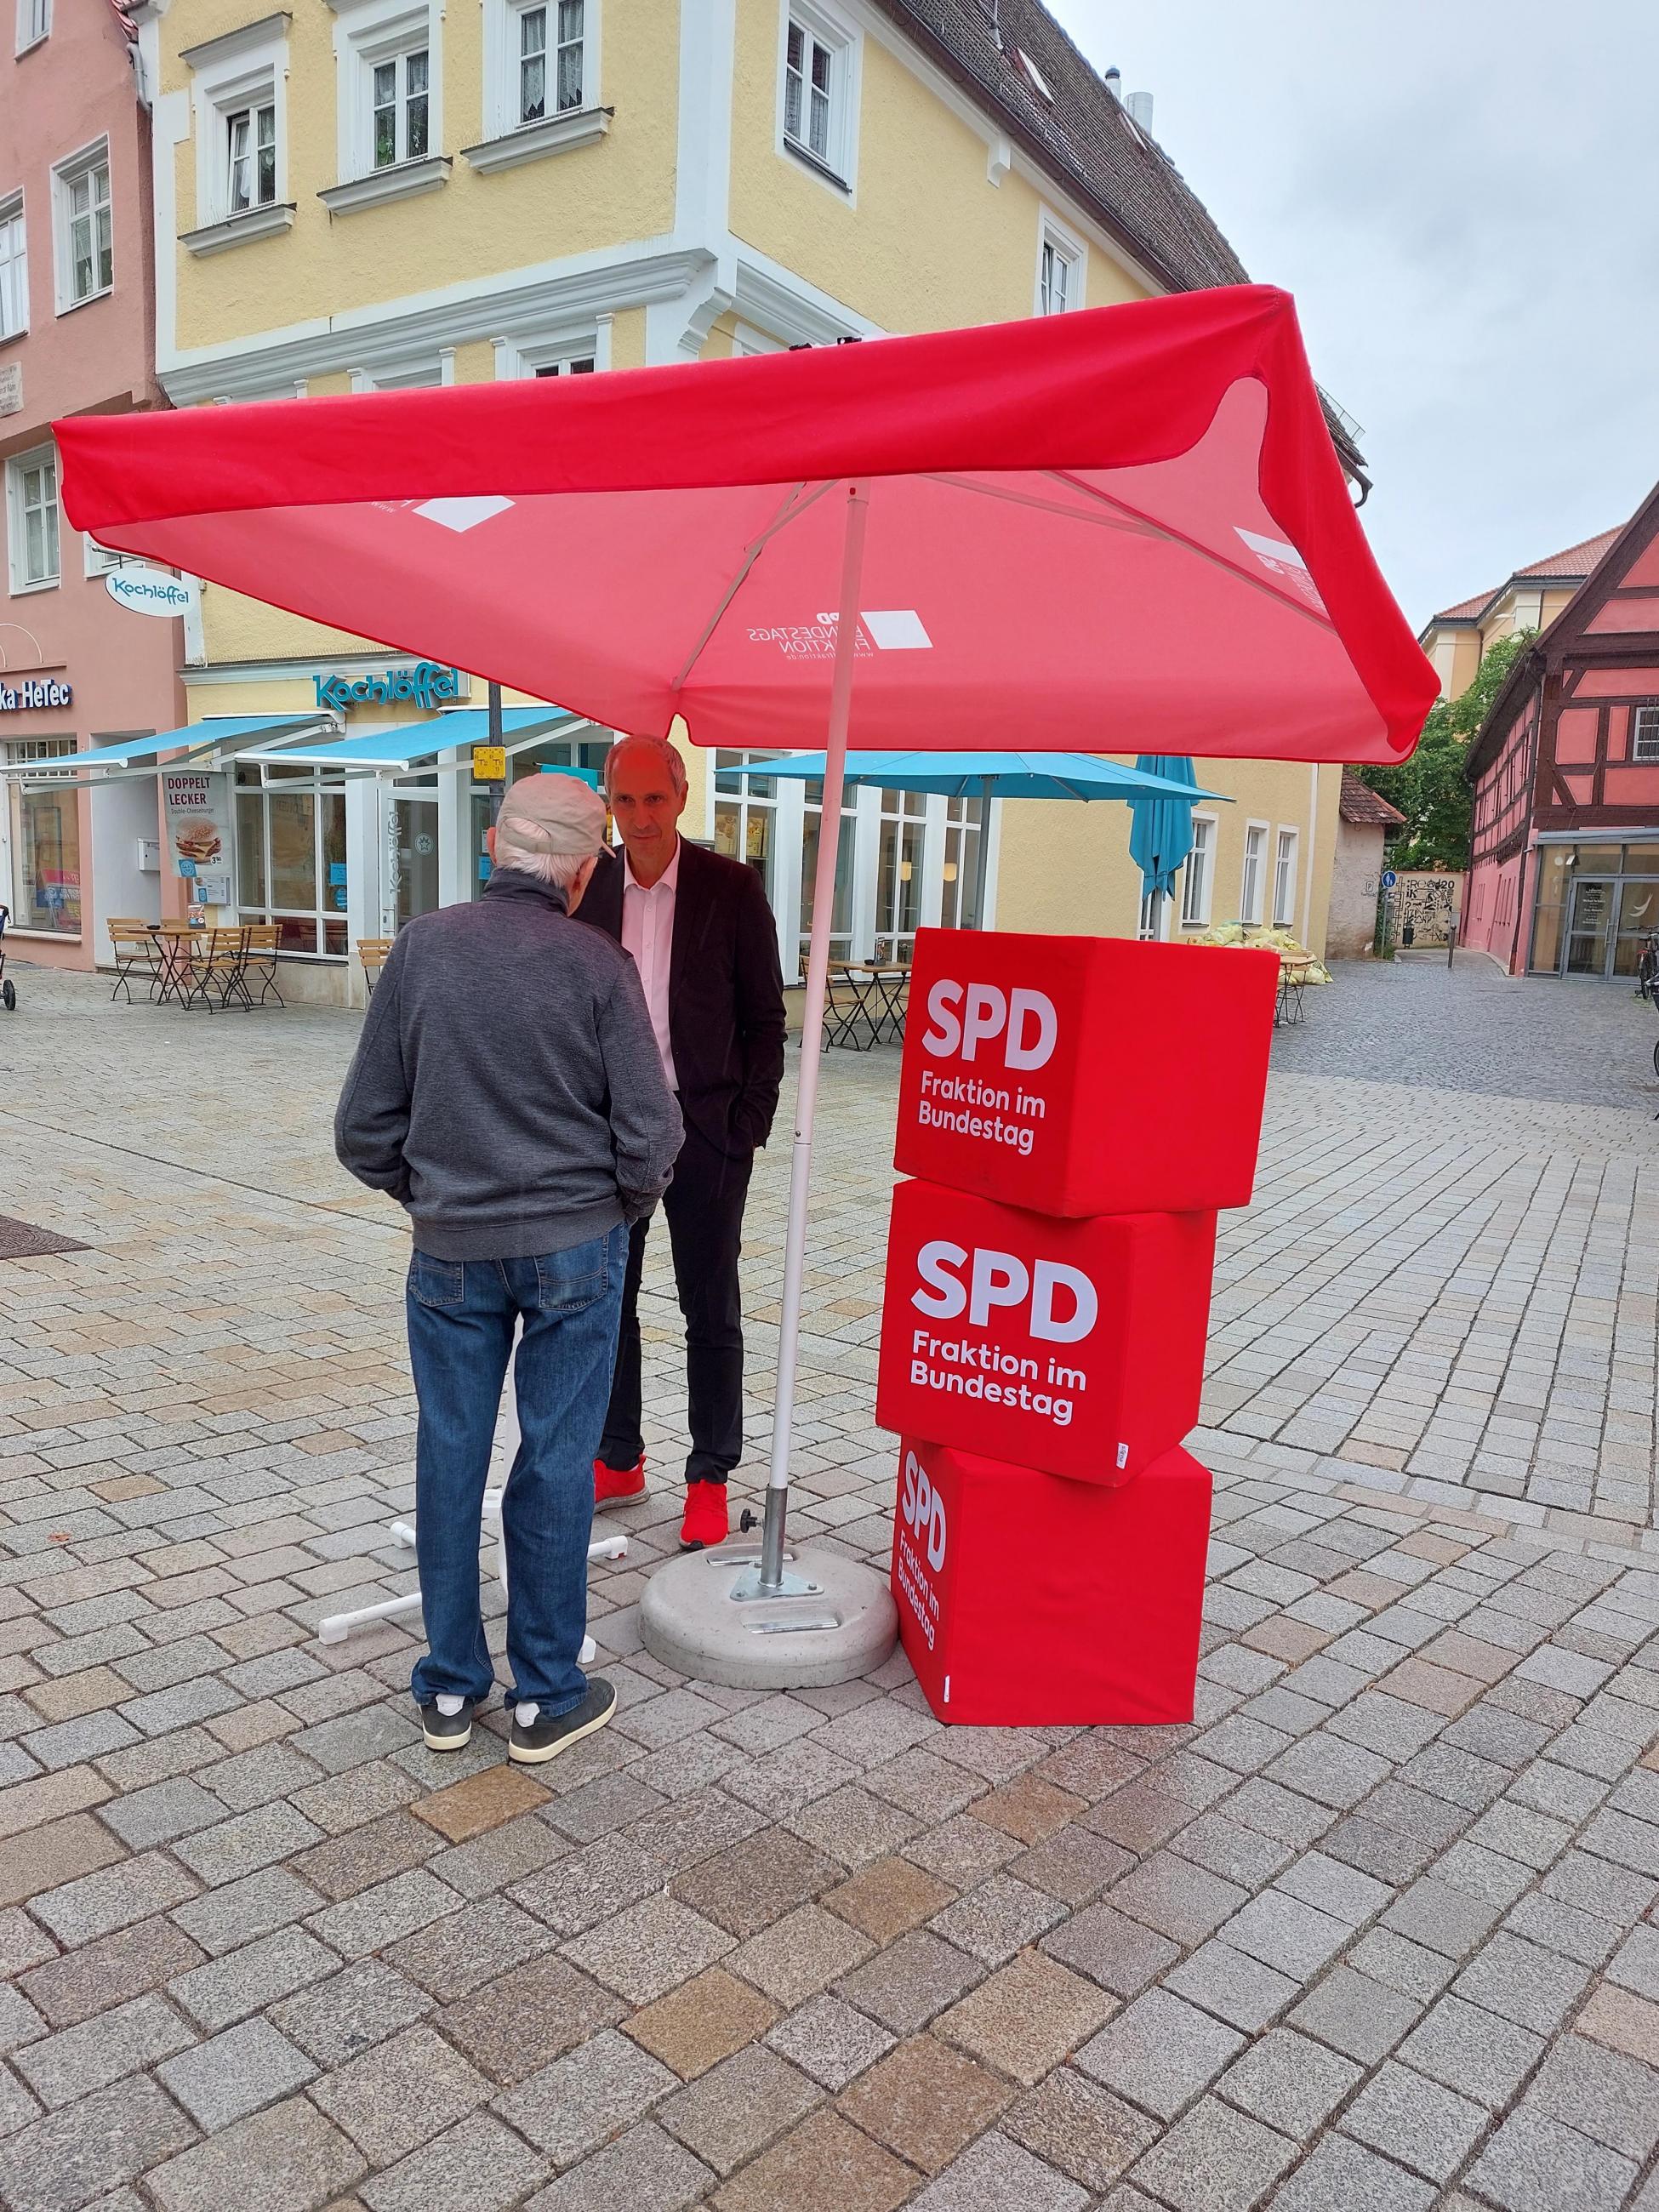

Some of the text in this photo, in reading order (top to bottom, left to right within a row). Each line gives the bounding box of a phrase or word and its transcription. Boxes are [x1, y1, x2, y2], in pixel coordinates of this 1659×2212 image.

[112, 578, 189, 605] Kochlöffel
[22, 679, 71, 708] HeTec
[312, 661, 459, 712] Kochlöffel
[168, 777, 211, 790] DOPPELT
[168, 793, 207, 805] LECKER
[388, 811, 402, 894] Kochlöffel
[921, 978, 1058, 1071] SPD
[921, 1070, 1046, 1119] Fraktion im
[918, 1100, 1035, 1155] Bundestag
[910, 1240, 1098, 1343] SPD
[912, 1329, 1086, 1391] Fraktion im
[910, 1360, 1074, 1426] Bundestag
[902, 1450, 947, 1573] SPD
[898, 1562, 935, 1651] Bundestag
[899, 1529, 940, 1622] Fraktion im
